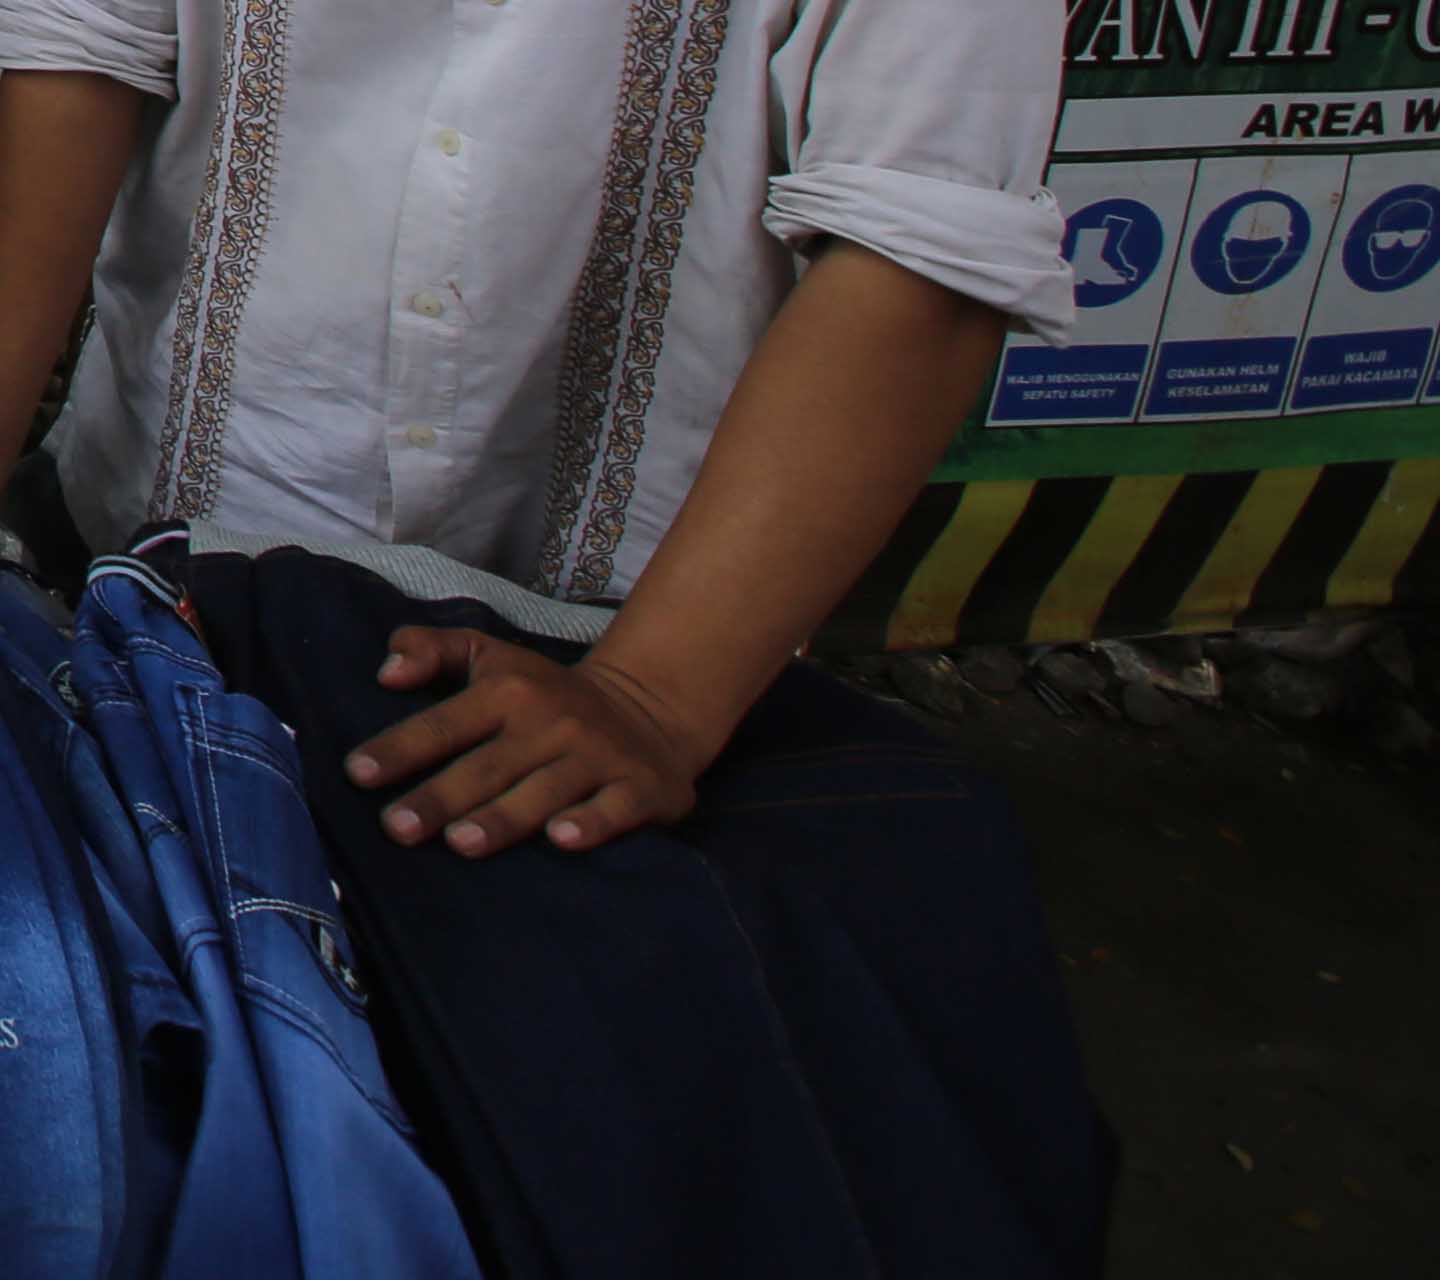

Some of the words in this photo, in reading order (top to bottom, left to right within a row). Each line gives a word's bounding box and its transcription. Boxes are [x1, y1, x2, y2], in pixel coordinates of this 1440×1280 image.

[1240, 100, 1386, 139] AREA
[1165, 366, 1238, 381] GUNAKAN
[1238, 363, 1280, 378] HELM
